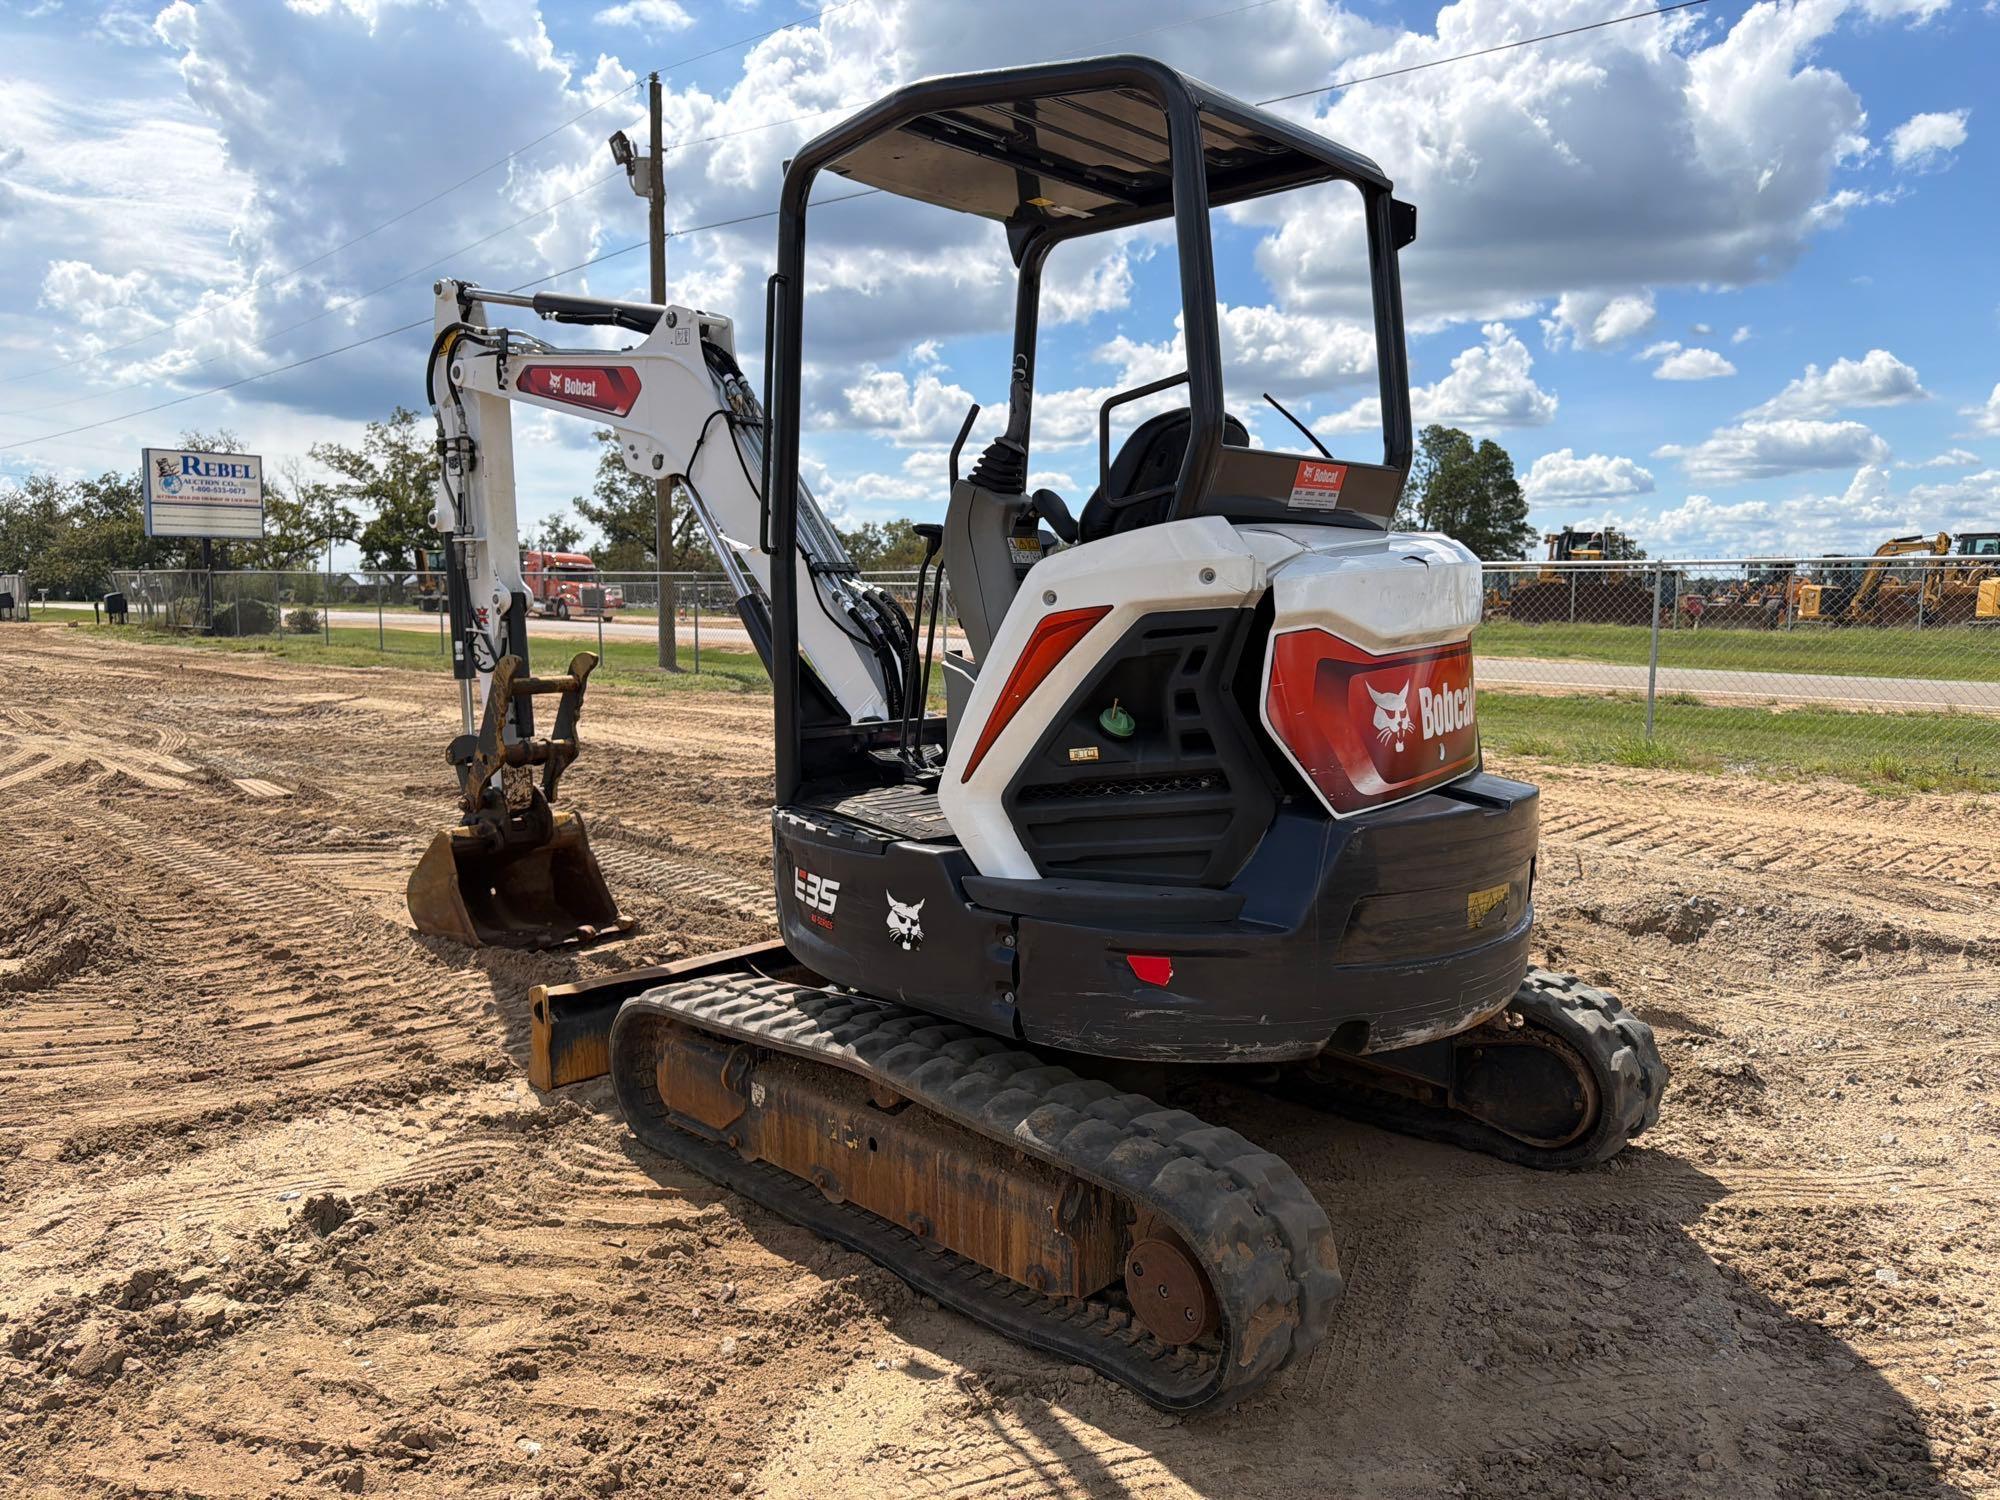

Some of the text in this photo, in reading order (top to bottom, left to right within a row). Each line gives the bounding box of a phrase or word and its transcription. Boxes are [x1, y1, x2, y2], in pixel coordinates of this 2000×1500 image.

[564, 377, 596, 397] Bobcat
[182, 479, 219, 487] AUCTION
[1313, 468, 1338, 484] Bobcat
[1419, 677, 1475, 740] Bobcat
[795, 866, 841, 915] E35
